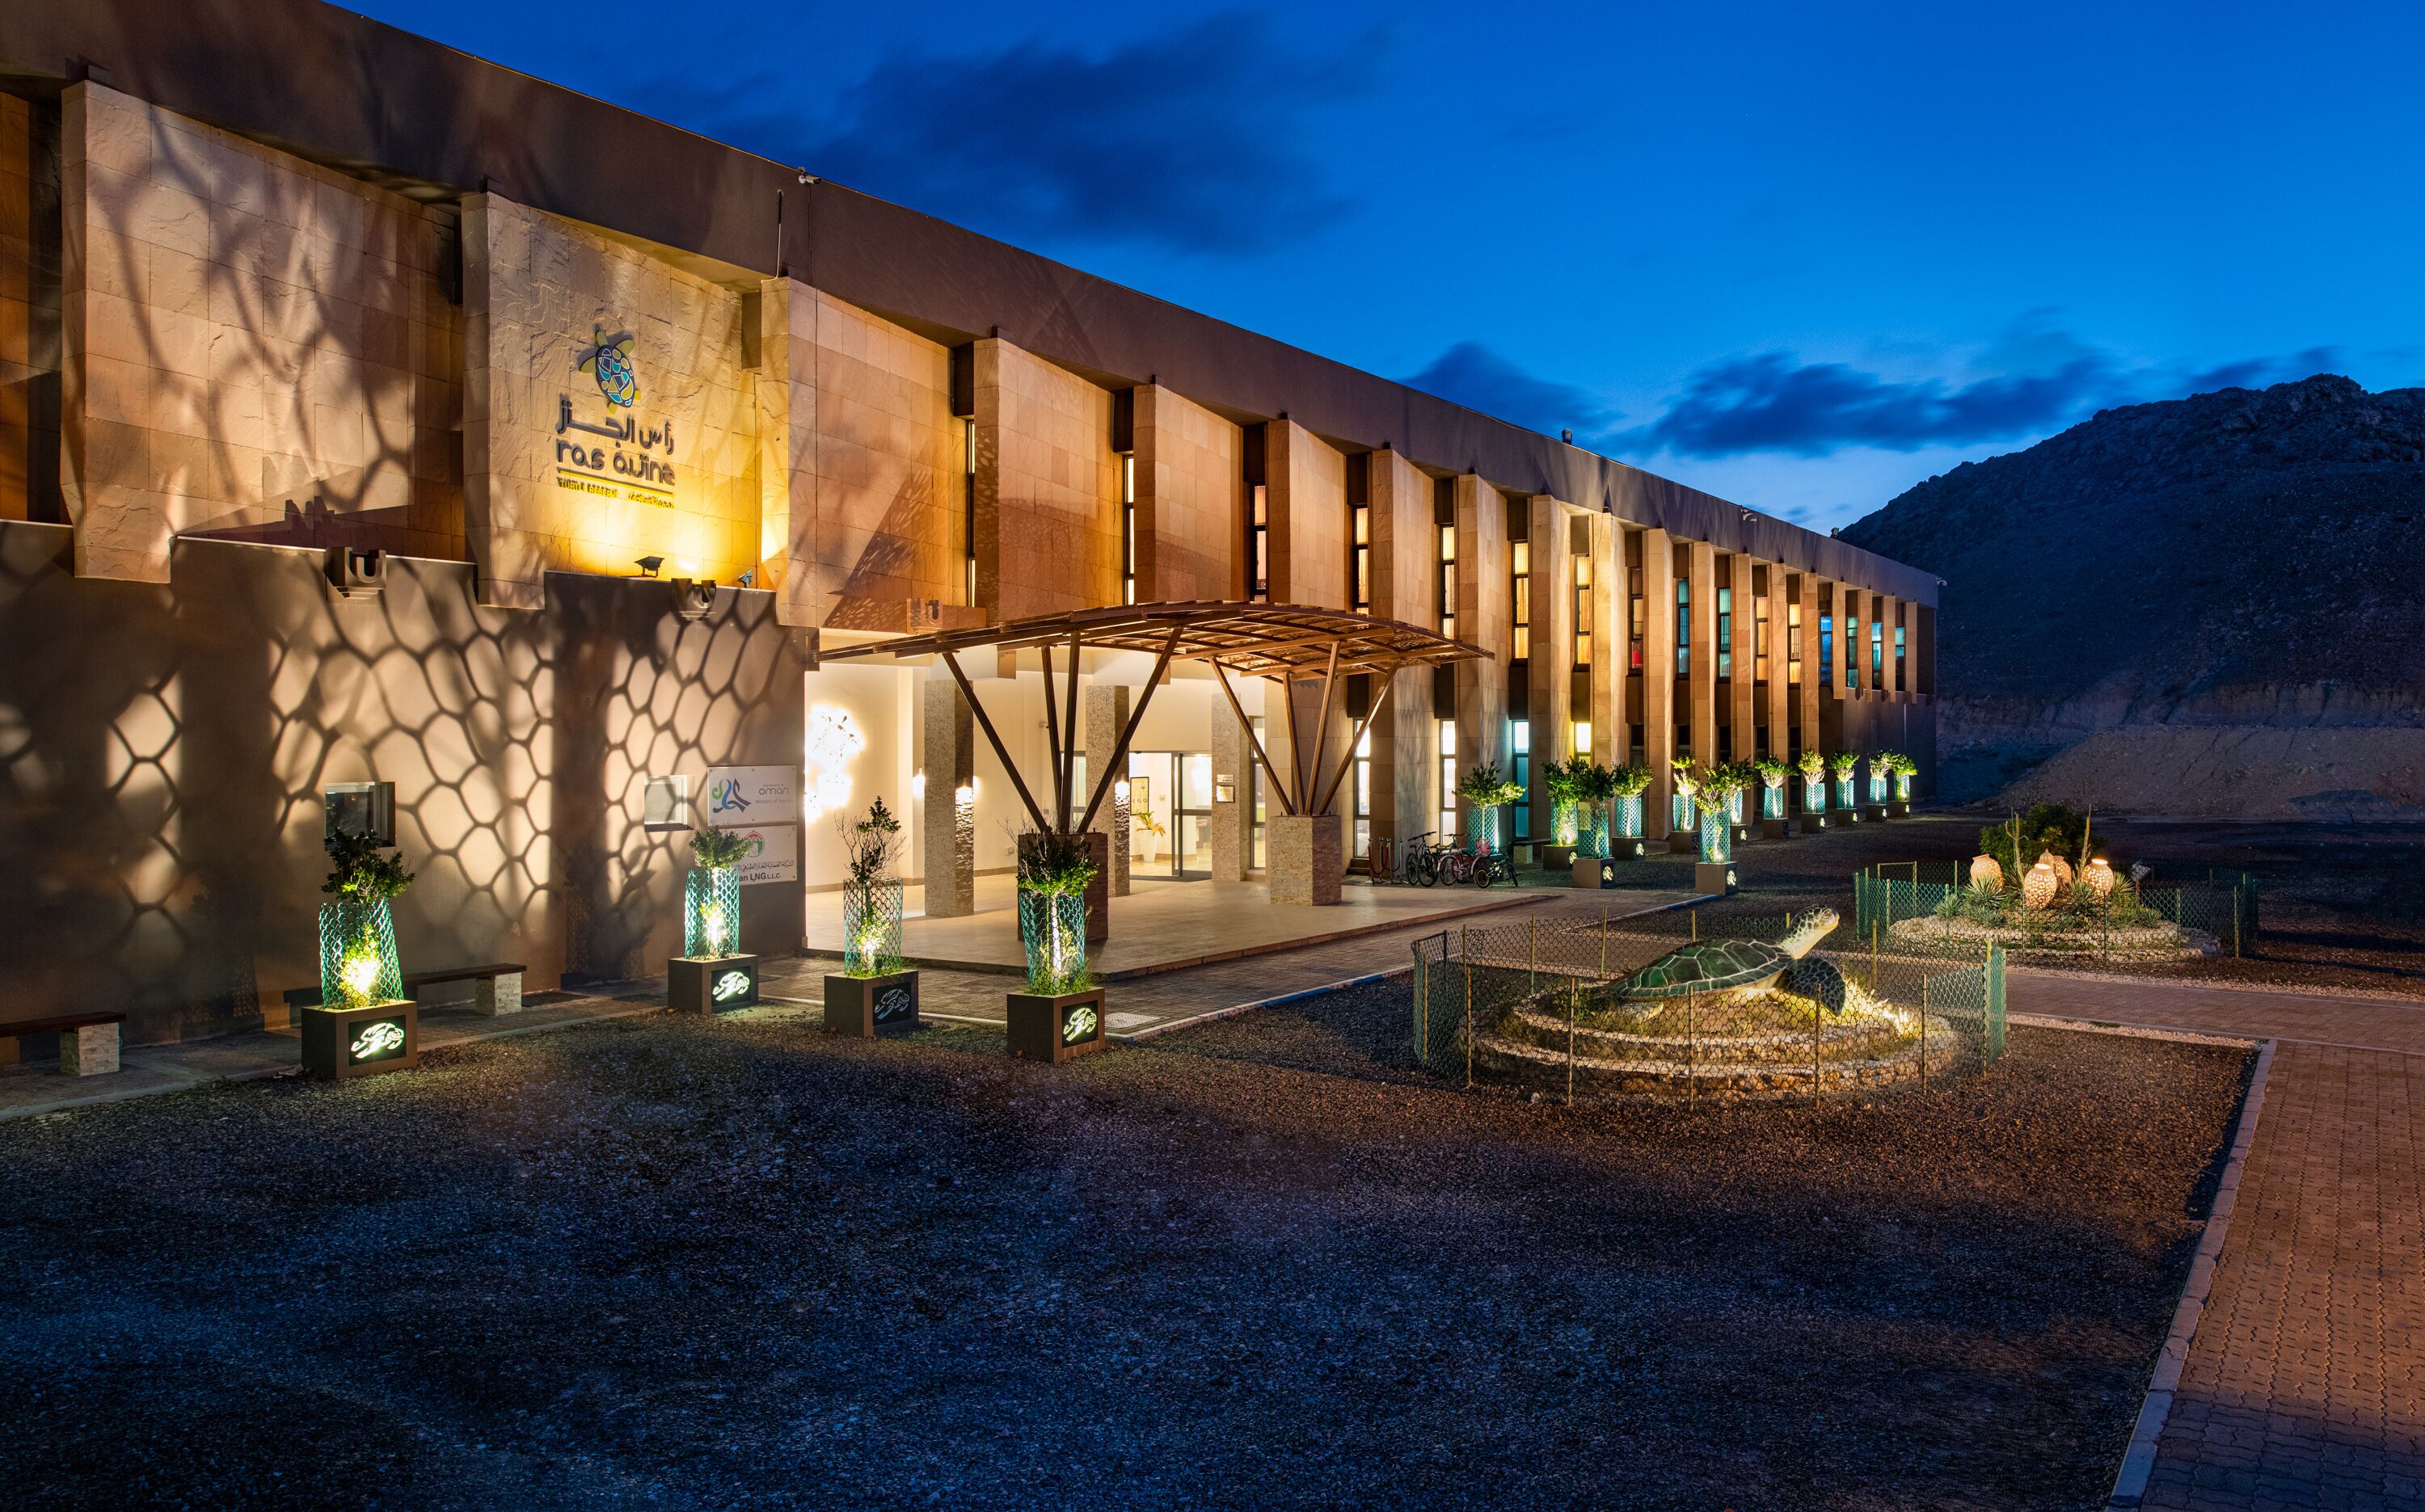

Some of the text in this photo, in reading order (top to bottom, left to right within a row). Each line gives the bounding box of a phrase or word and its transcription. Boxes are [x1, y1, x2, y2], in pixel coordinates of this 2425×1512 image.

[639, 419, 674, 455] رأس
[556, 439, 605, 470] ras
[759, 787, 789, 795] oman
[750, 873, 766, 882] LNG
